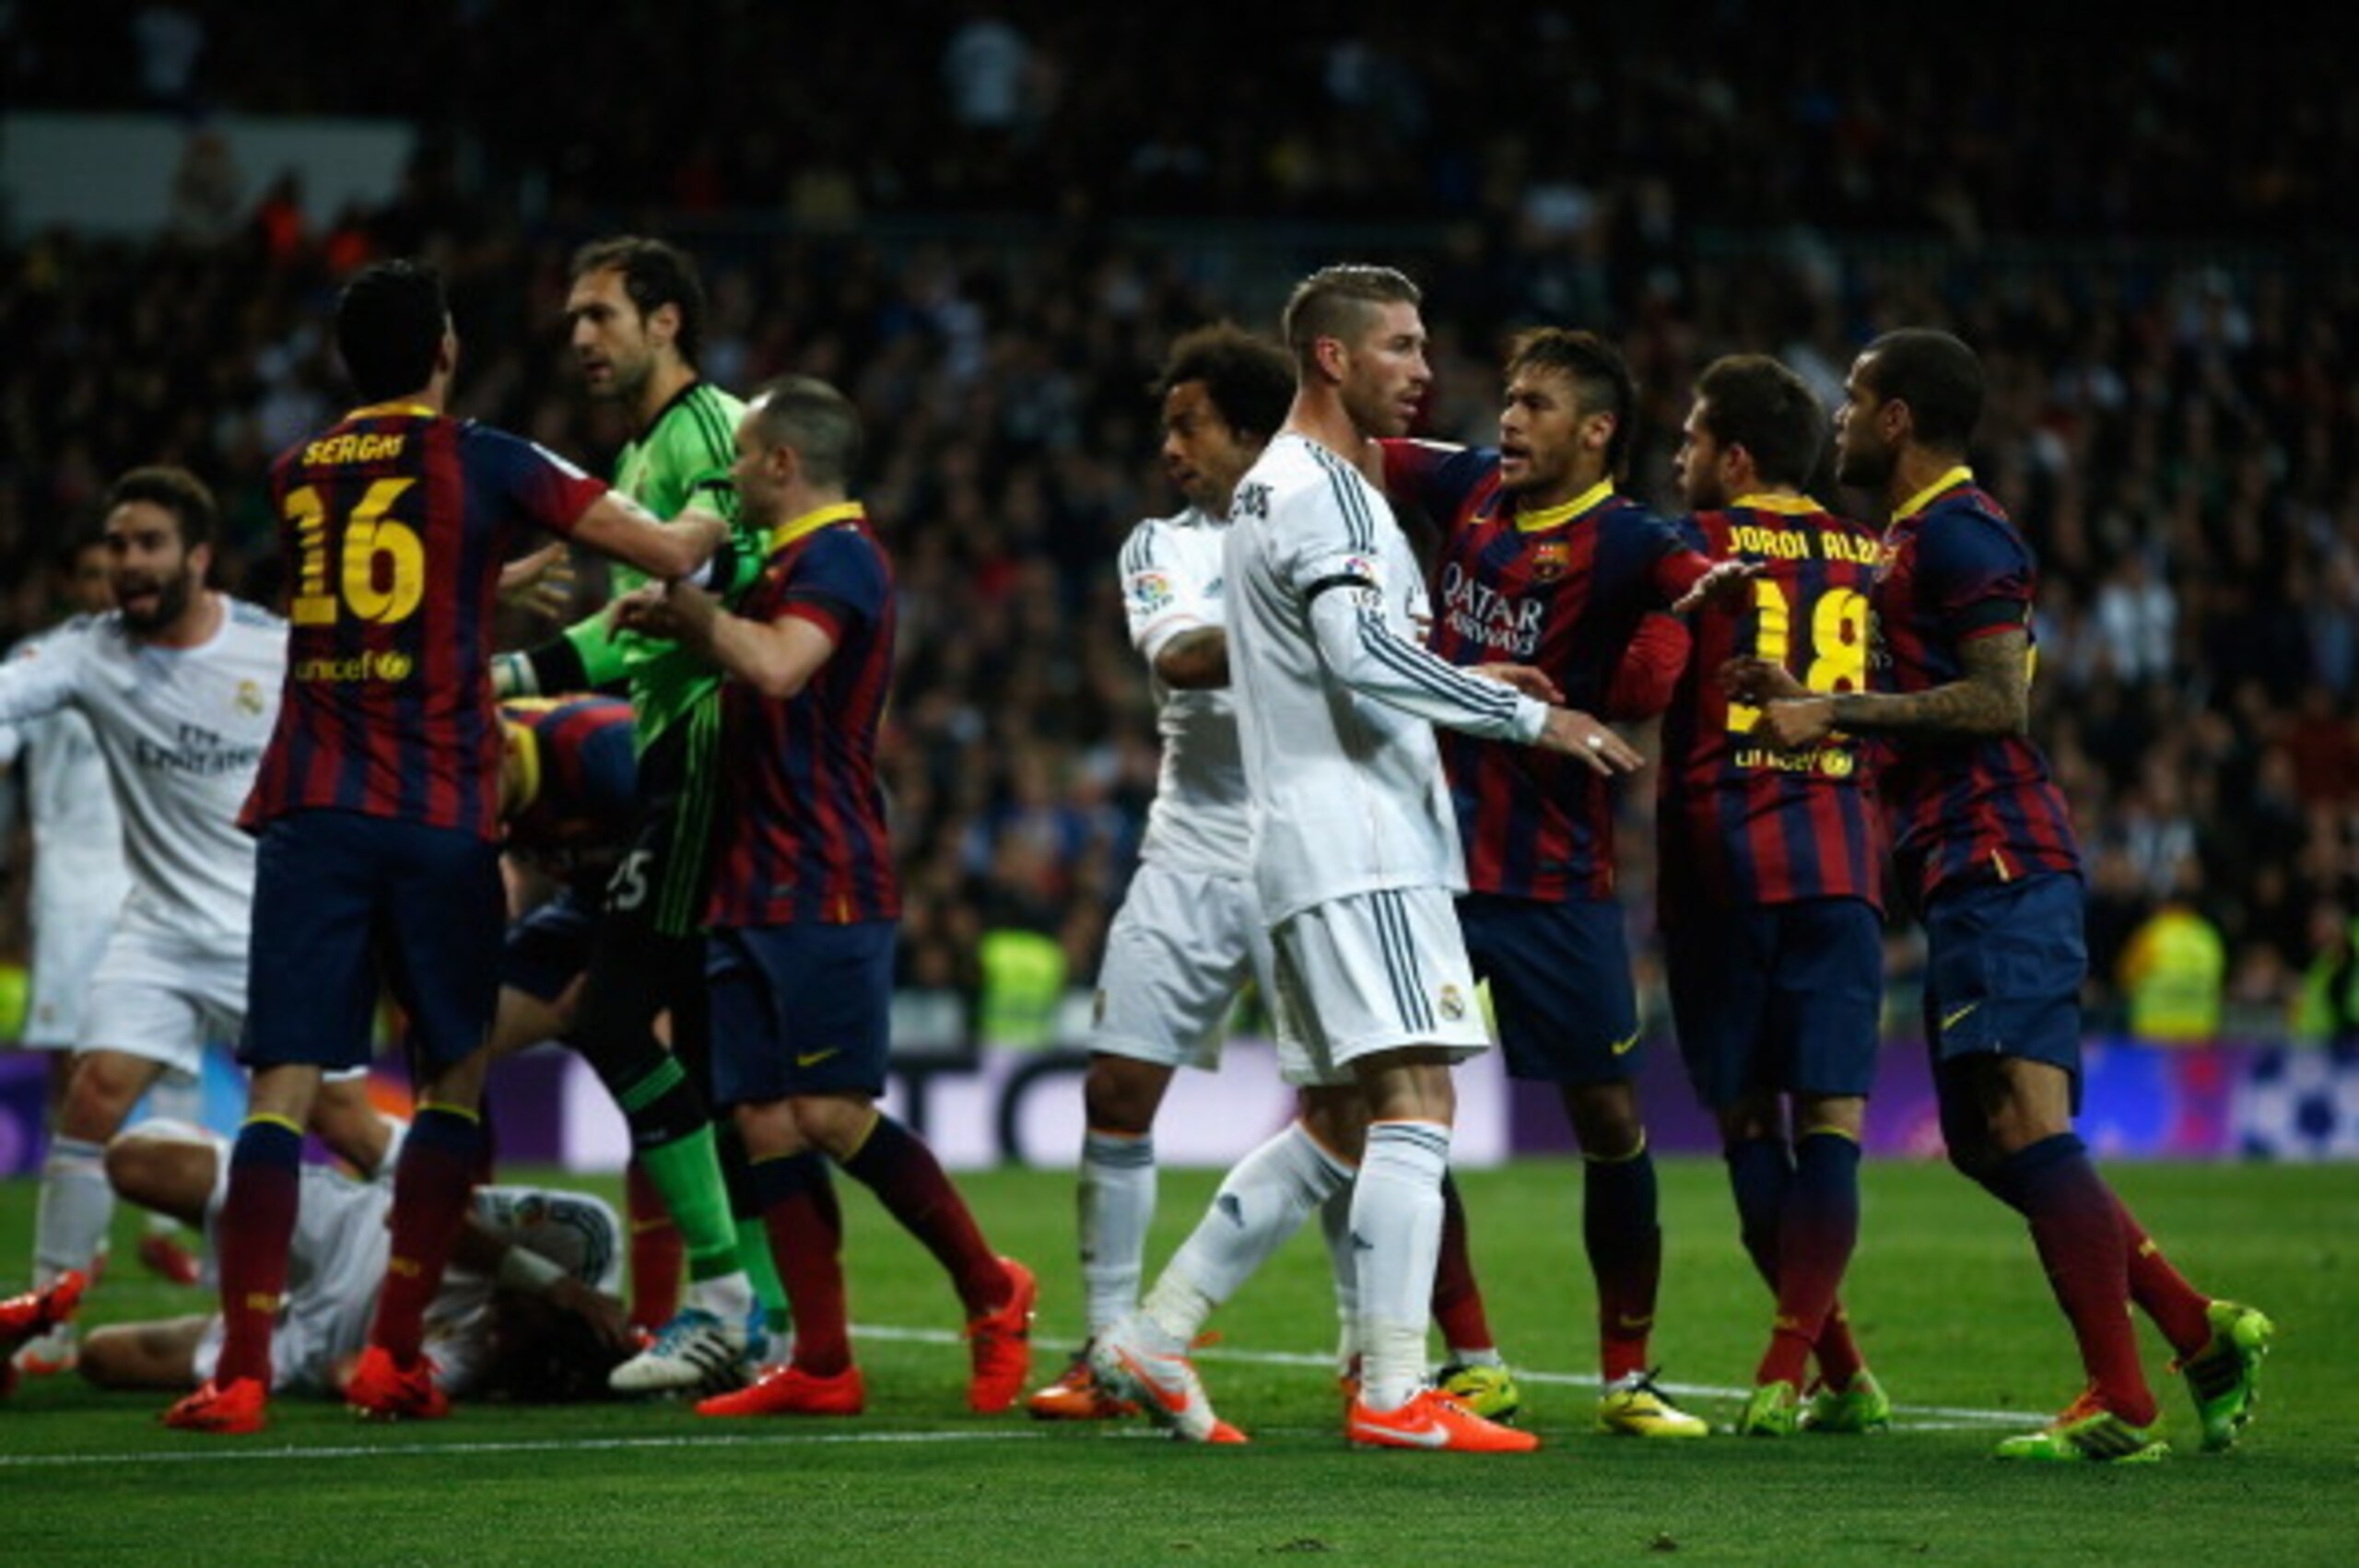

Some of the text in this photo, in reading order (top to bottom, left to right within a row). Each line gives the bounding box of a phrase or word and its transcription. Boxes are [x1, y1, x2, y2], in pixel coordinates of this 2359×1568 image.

[283, 476, 426, 626] 16
[1726, 525, 1812, 560] JORDI
[1443, 561, 1544, 633] QATAR
[295, 649, 372, 682] unicef
[1726, 578, 1869, 741] 18
